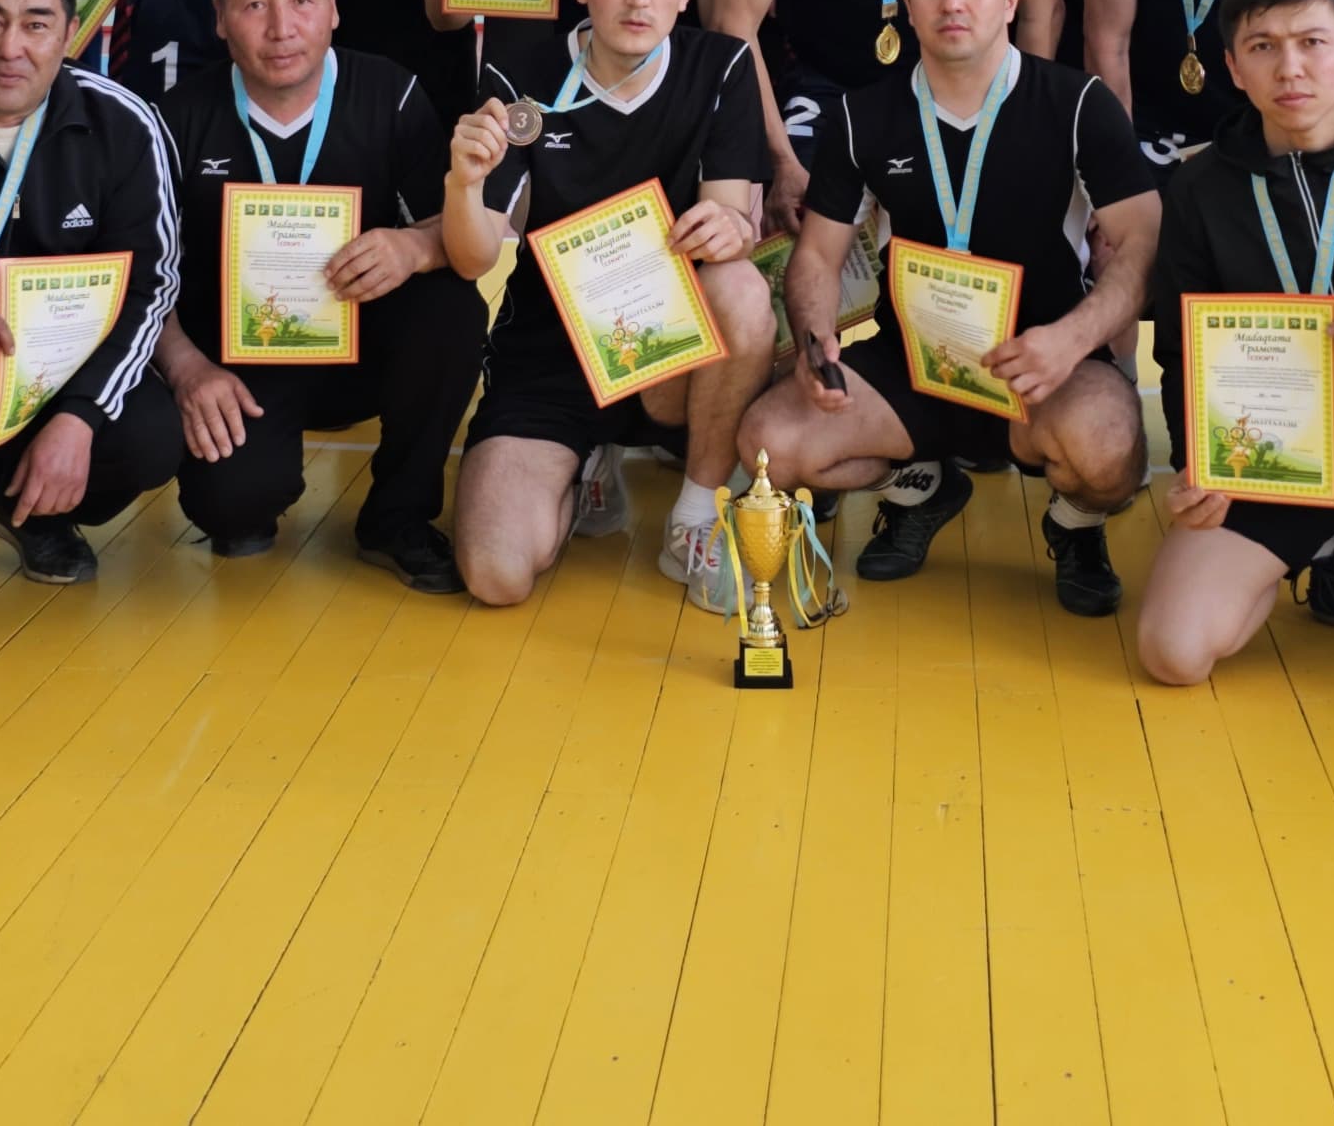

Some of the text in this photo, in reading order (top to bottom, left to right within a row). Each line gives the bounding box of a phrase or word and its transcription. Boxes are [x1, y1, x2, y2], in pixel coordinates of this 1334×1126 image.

[151, 40, 179, 93] 1
[515, 112, 528, 129] 3
[783, 96, 822, 137] 2
[62, 218, 94, 229] adidas
